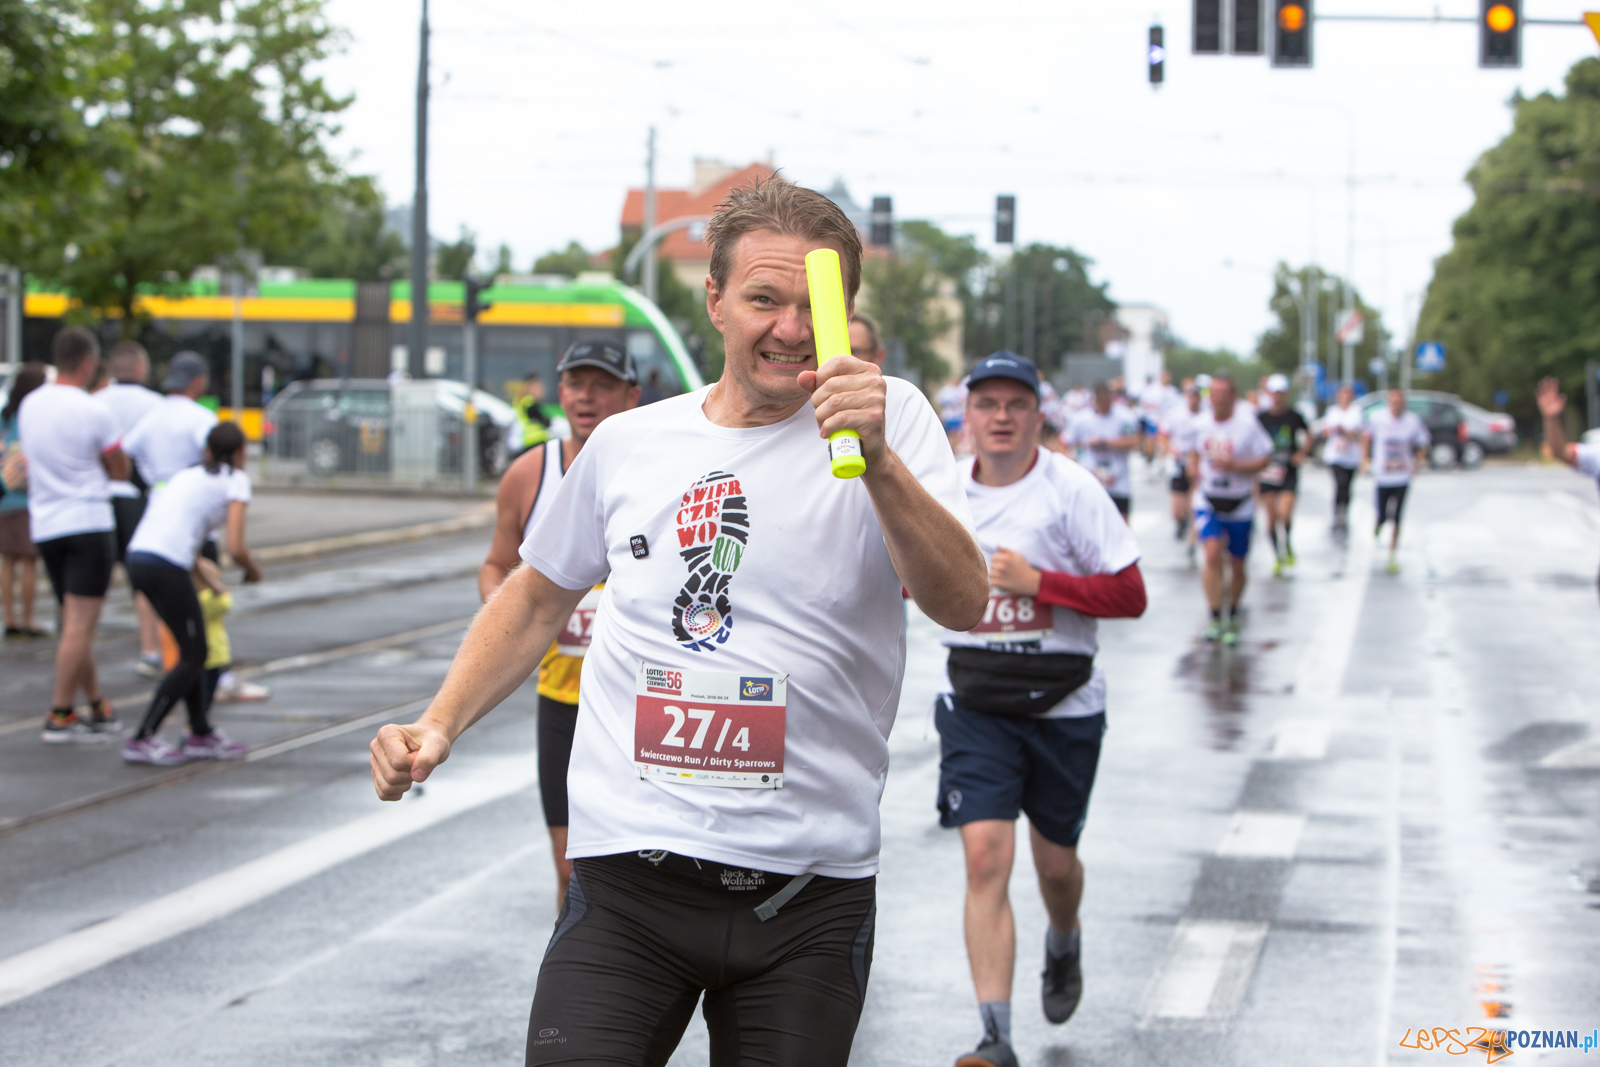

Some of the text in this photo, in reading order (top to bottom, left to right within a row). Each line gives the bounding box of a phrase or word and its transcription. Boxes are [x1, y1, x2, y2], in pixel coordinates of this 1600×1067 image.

[676, 499, 720, 525] CZE
[676, 521, 718, 548] WO
[711, 536, 745, 573] RUN
[646, 668, 664, 677] LOTTO
[748, 686, 765, 695] LOTTO
[660, 705, 751, 753] 27/4
[640, 747, 776, 769] Świerczewo Run / Dirty Sparrows
[720, 869, 745, 878] Jack
[720, 876, 766, 886] Wolfskin
